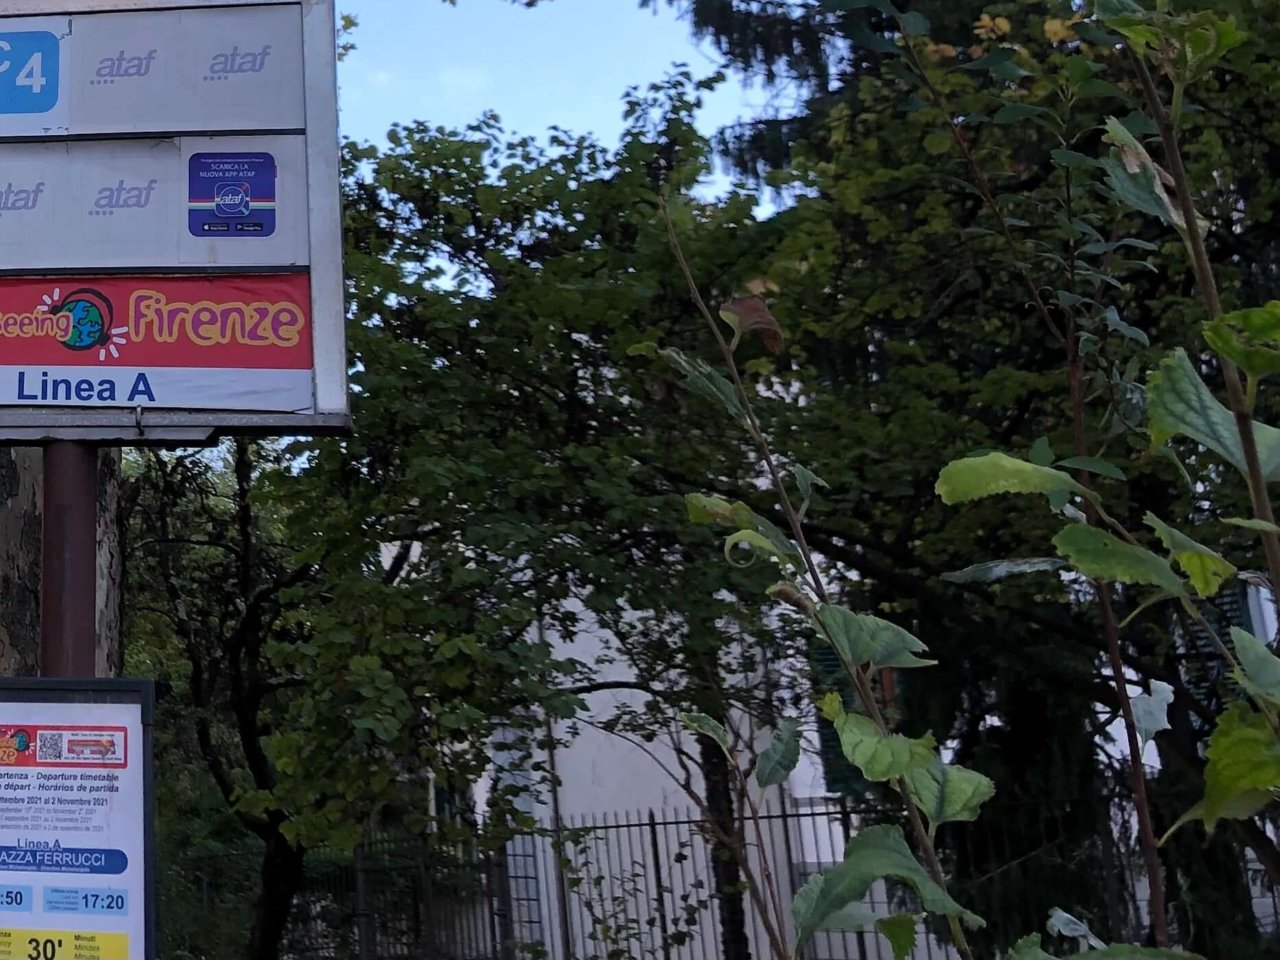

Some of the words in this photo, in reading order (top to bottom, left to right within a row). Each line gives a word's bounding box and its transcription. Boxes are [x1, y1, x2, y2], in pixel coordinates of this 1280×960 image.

[95, 49, 157, 78] ataf
[208, 45, 271, 74] ataf
[94, 179, 157, 209] ataf
[221, 193, 243, 204] ataf
[128, 289, 306, 347] Firenze
[17, 371, 117, 402] Linea
[127, 372, 157, 402] A
[36, 772, 78, 781] Departure
[80, 772, 119, 782] timetable
[4, 781, 31, 792] départ
[76, 783, 87, 792] de
[89, 784, 119, 793] partida
[57, 797, 91, 806] Novembre
[17, 838, 49, 850] Linea
[51, 839, 61, 850] A
[36, 852, 105, 866] FERRUCCI
[82, 893, 125, 910] 17:20
[74, 934, 96, 942] Minuti
